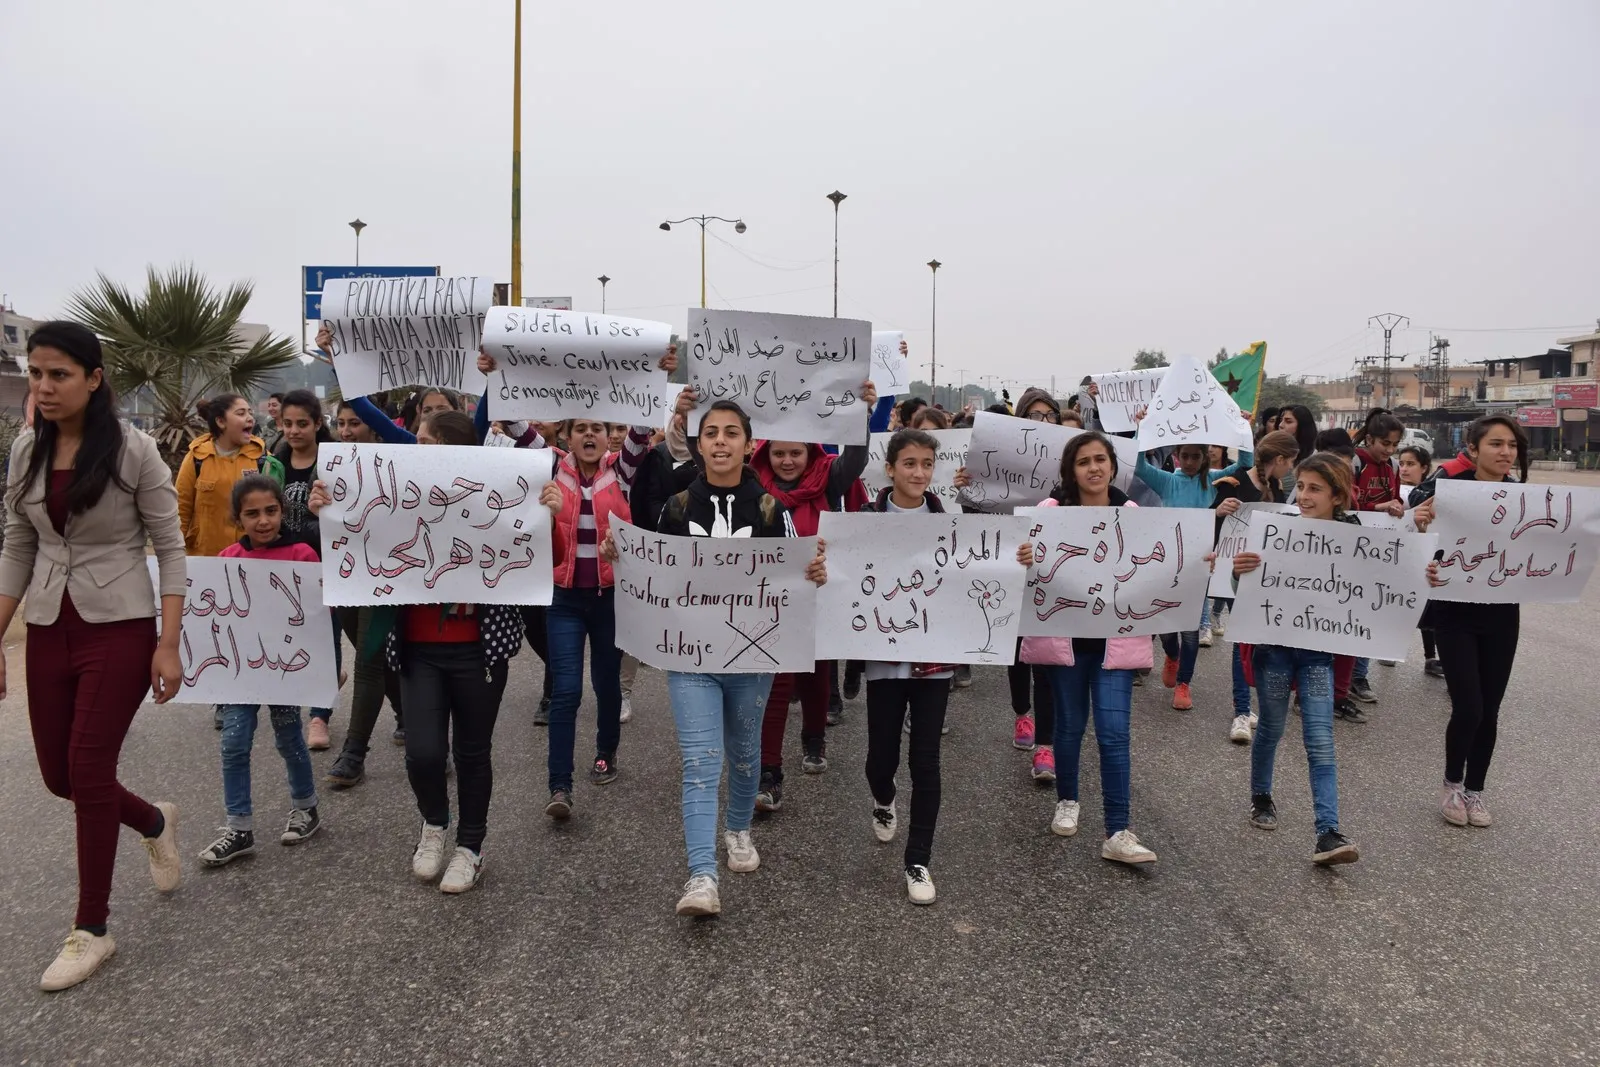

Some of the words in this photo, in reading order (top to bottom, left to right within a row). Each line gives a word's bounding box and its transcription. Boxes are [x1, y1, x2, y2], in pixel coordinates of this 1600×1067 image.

[432, 276, 478, 316] RAST
[585, 316, 599, 337] li
[747, 335, 785, 360] ضد
[796, 336, 856, 365] العنف
[377, 350, 466, 391] AFRANDIN
[753, 369, 812, 412] ضياع
[816, 389, 856, 419] هو
[1099, 379, 1145, 404] VIOLENCE
[1029, 523, 1089, 583] حرة
[269, 568, 305, 627] لا
[861, 563, 943, 602] زهرة
[1027, 578, 1088, 622] حرة
[851, 598, 929, 645] الحياة
[1088, 582, 1182, 634] حياة
[1292, 604, 1371, 641] afrandin
[246, 631, 311, 681] ضد
[655, 629, 714, 667] dikuje
